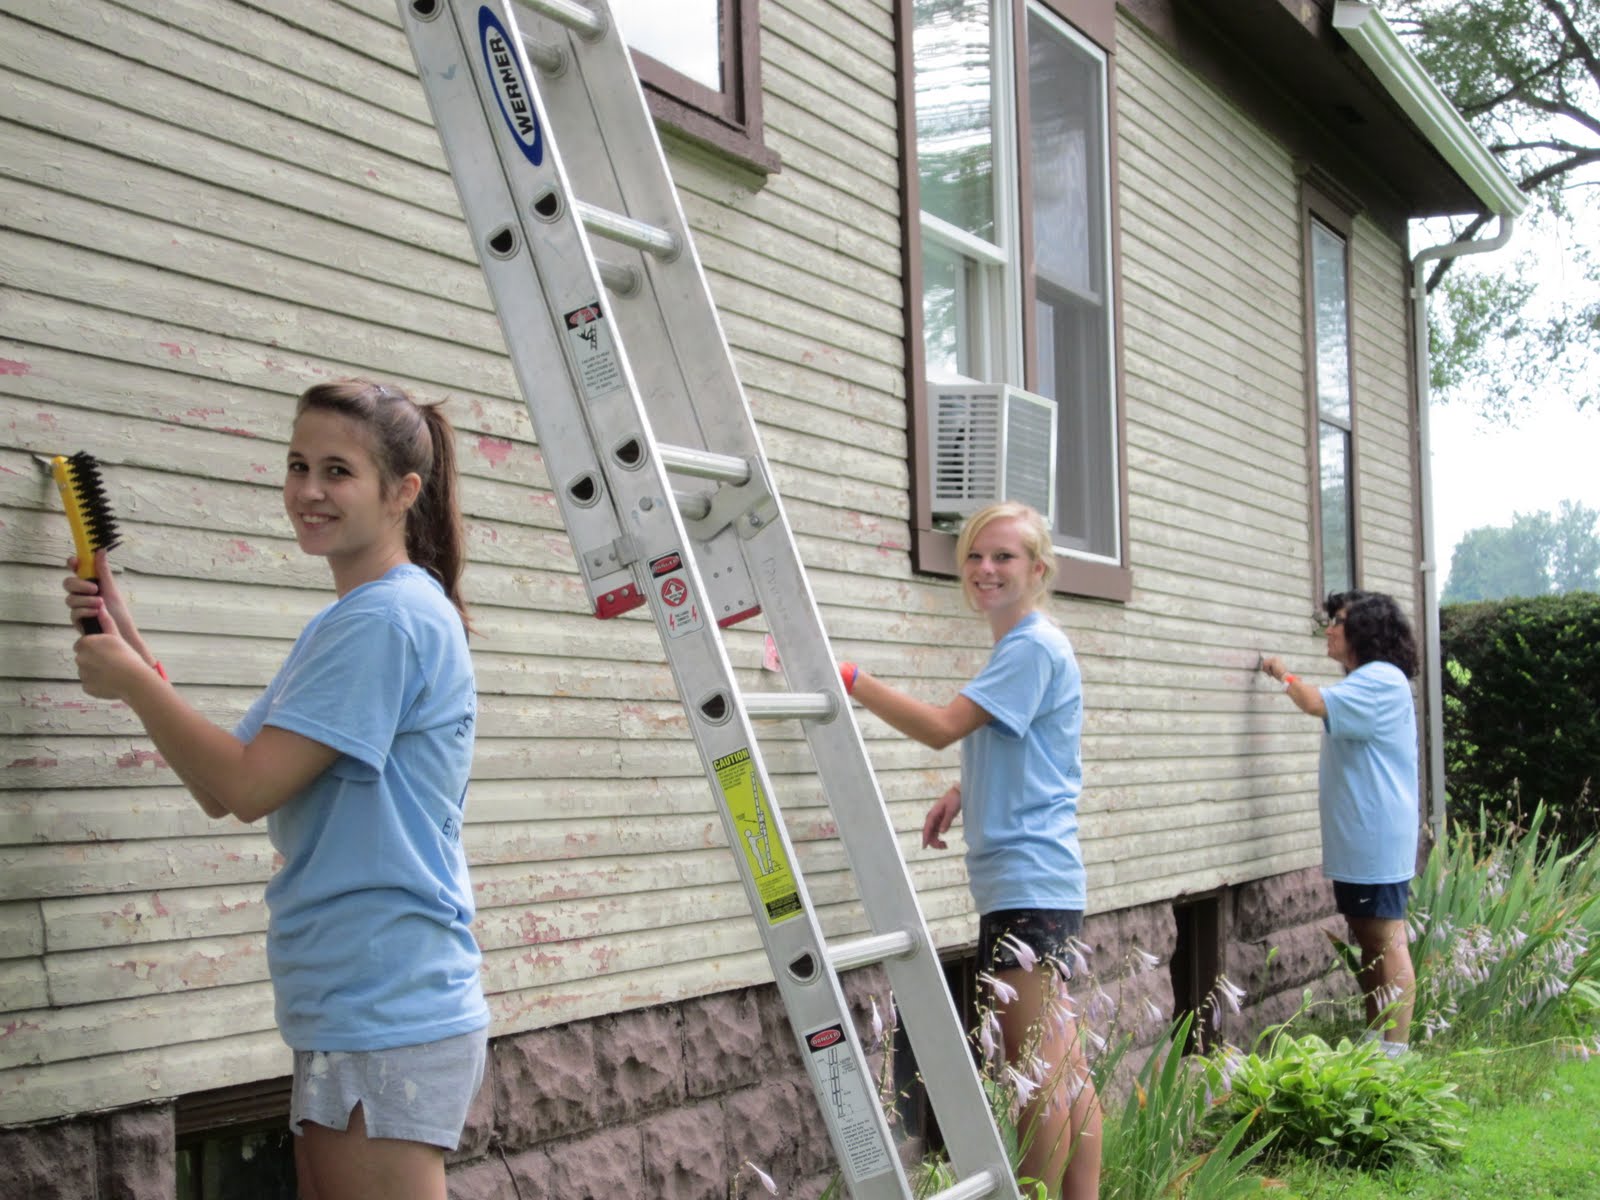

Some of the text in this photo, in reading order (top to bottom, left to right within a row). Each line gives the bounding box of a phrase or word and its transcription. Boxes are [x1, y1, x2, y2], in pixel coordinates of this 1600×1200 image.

[490, 37, 534, 135] WERNER
[713, 749, 749, 771] CAUTION
[812, 1032, 839, 1045] DANGER
